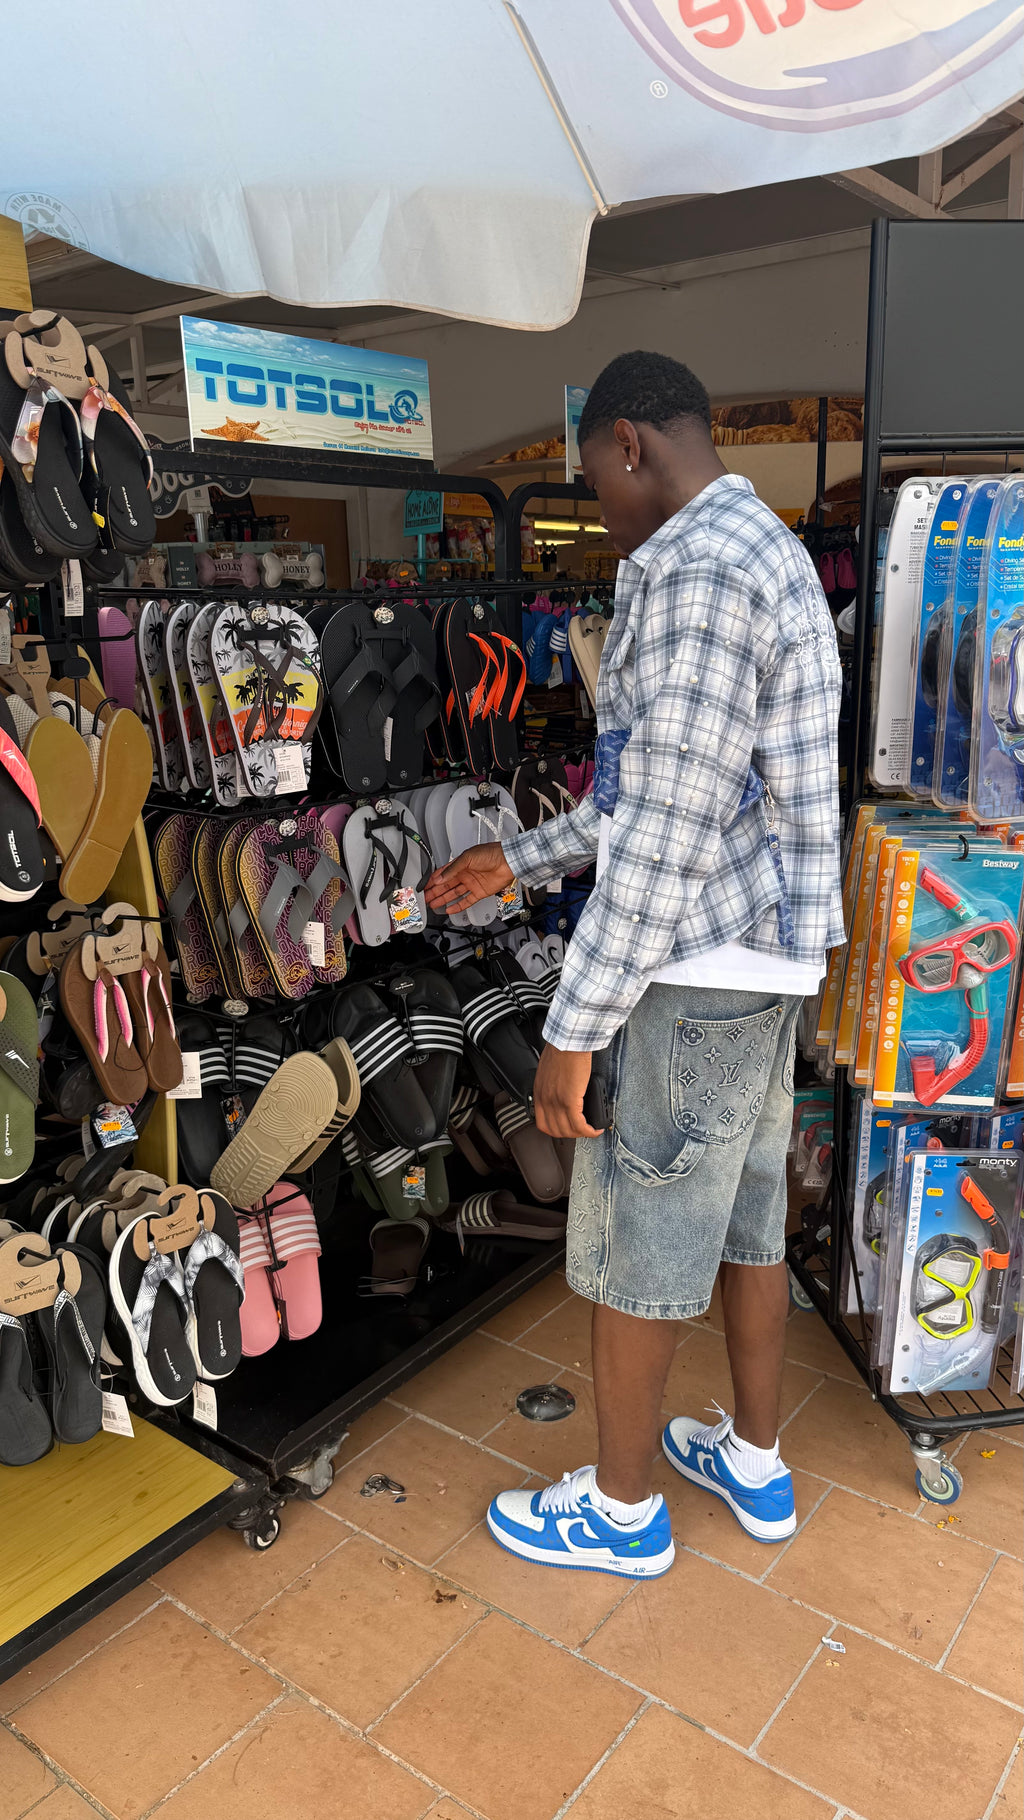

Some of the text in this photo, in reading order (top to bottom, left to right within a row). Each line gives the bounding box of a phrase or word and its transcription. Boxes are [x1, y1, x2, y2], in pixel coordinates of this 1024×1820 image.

[214, 563, 243, 572] HOLLY
[283, 565, 311, 574] HONEY
[8, 830, 22, 868] TOTSOL
[982, 859, 1020, 870] Bestway
[979, 1158, 1018, 1168] monty
